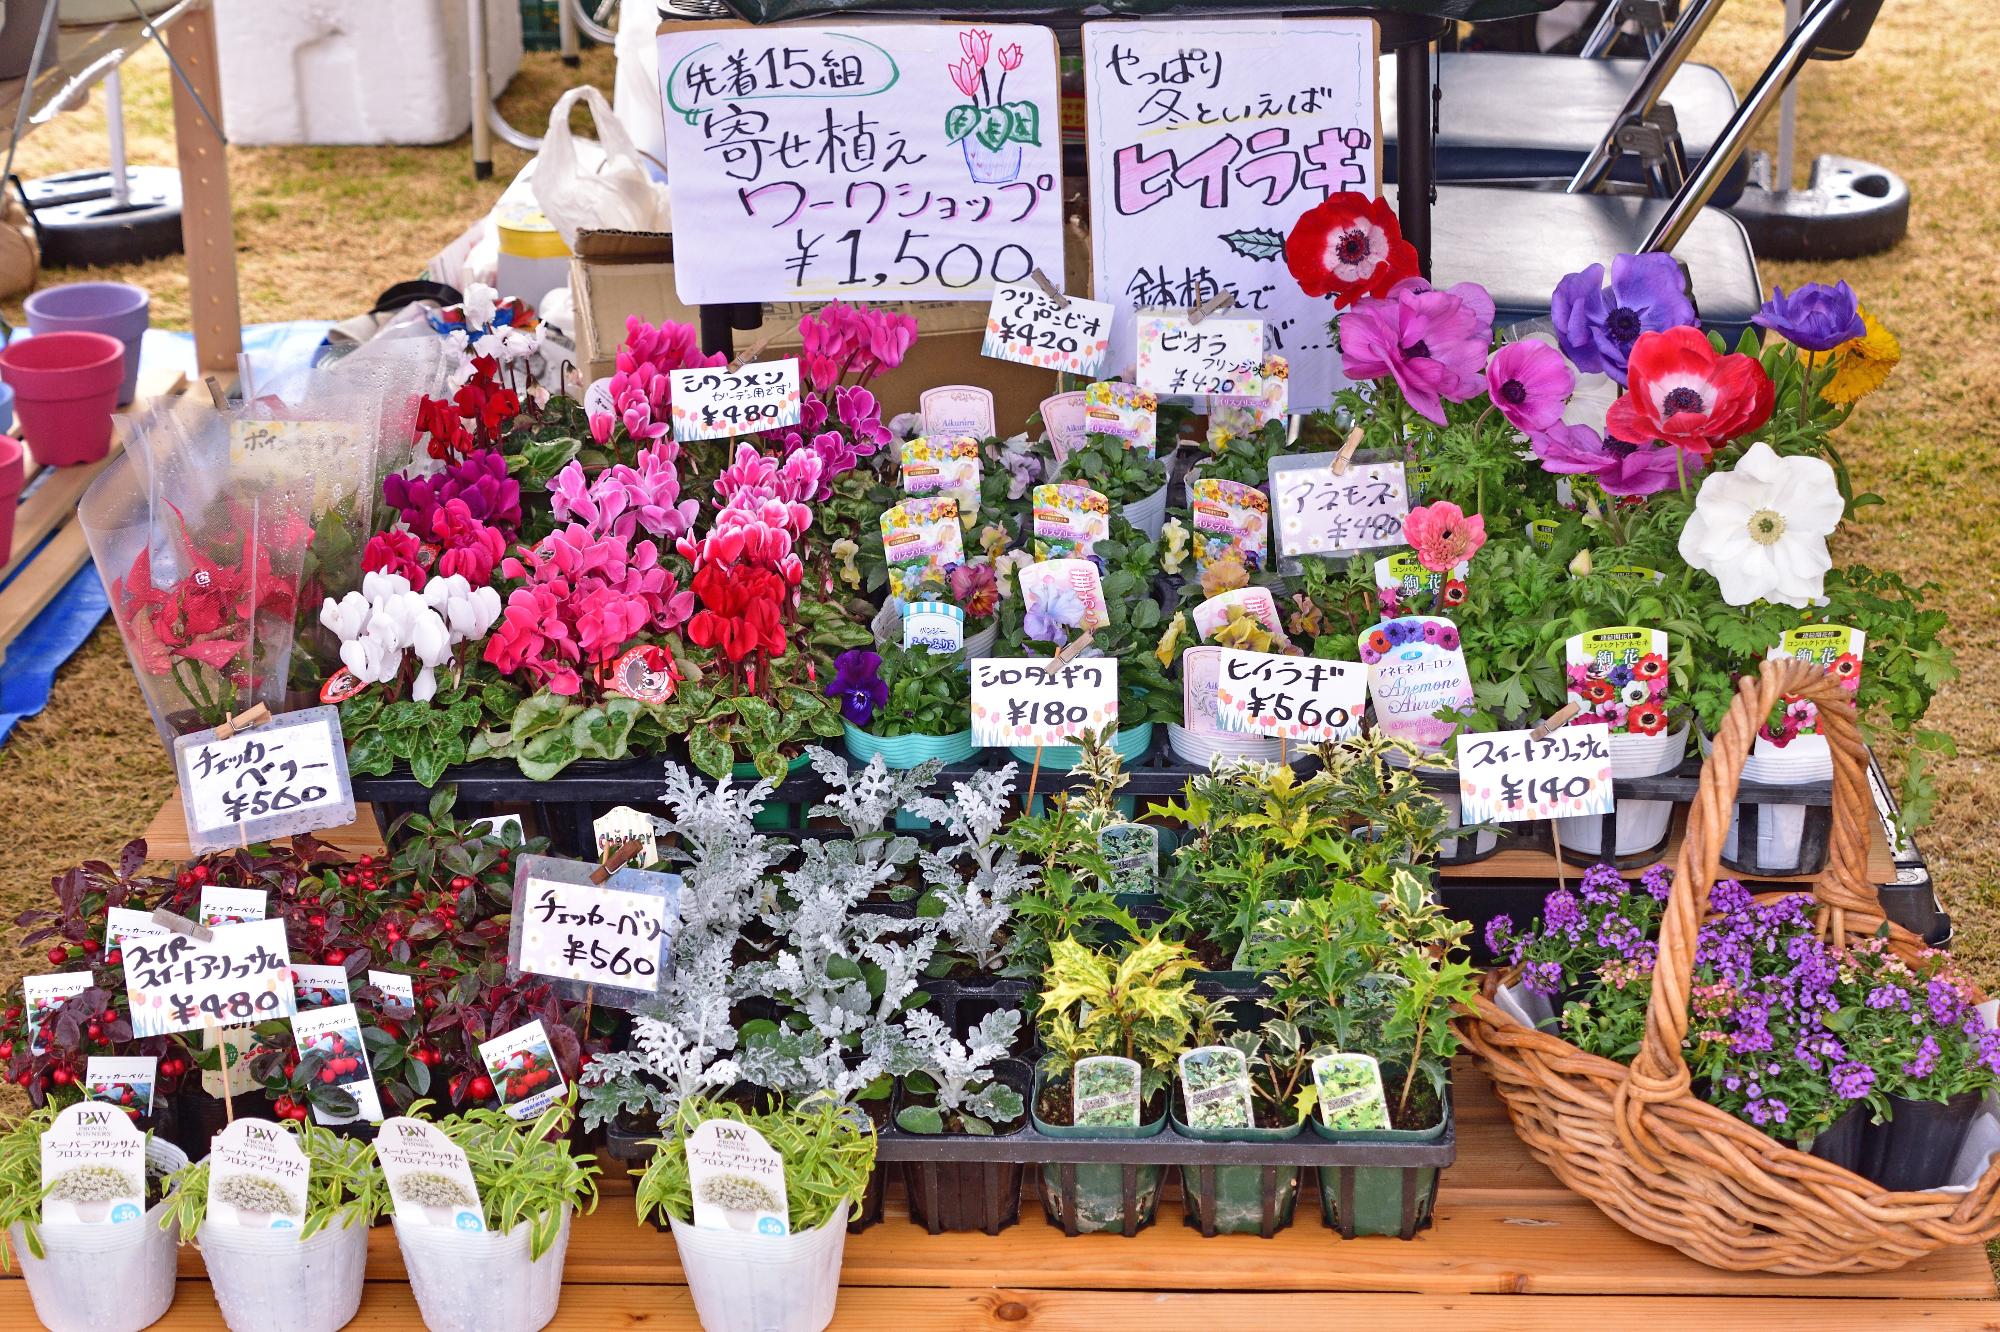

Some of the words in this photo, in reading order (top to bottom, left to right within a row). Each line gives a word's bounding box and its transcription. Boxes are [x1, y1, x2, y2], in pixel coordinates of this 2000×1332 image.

[686, 48, 865, 104] 先着15組
[1106, 44, 1222, 88] やっぱり
[1138, 86, 1333, 130] 冬といえば
[704, 103, 927, 181] 寄せ植え
[1113, 128, 1371, 215] ヒイラギ
[738, 174, 1056, 228] ワークショップ
[786, 230, 1033, 288] ¥1,500
[999, 316, 1078, 353] ¥420
[1161, 333, 1227, 355] ビオラ
[682, 371, 784, 394] シクラメン
[1169, 367, 1235, 394] ¥420
[702, 404, 779, 427] ¥480
[1283, 476, 1396, 514] アネモネ
[1327, 513, 1402, 547] ¥480
[1586, 640, 1650, 650] コンパクトアネモネ
[1787, 639, 1849, 648] コンパクトアネモネ
[1227, 657, 1345, 691] ヒイラギ
[1377, 677, 1461, 699] Anemone
[1006, 698, 1088, 726] ¥180
[1247, 686, 1350, 728] ¥560
[1387, 694, 1460, 715] Aurora
[192, 741, 284, 780] チェッカー
[1467, 733, 1610, 769] スイートアリッサム
[236, 759, 329, 789] ベリー
[222, 785, 328, 822] ¥560
[1500, 773, 1591, 809] ¥140
[202, 903, 263, 915] チェッカーベリー
[135, 945, 286, 990] スイートアリッサム
[563, 934, 656, 976] ¥560
[169, 991, 279, 1026] ¥480
[295, 1017, 354, 1035] チェッカーベリー
[485, 1033, 544, 1060] チェッカーベリー
[89, 1072, 152, 1081] チェッカーベリー
[76, 1111, 111, 1126] PW
[396, 1125, 427, 1137] PW
[48, 1140, 140, 1149] スーパーアリッサム
[246, 1125, 278, 1142] PW
[714, 1126, 748, 1142] PW
[215, 1144, 304, 1172] スーパーアリッサム
[382, 1146, 464, 1162] スーパーアリッサム
[691, 1146, 779, 1168] スーパーアリッサム
